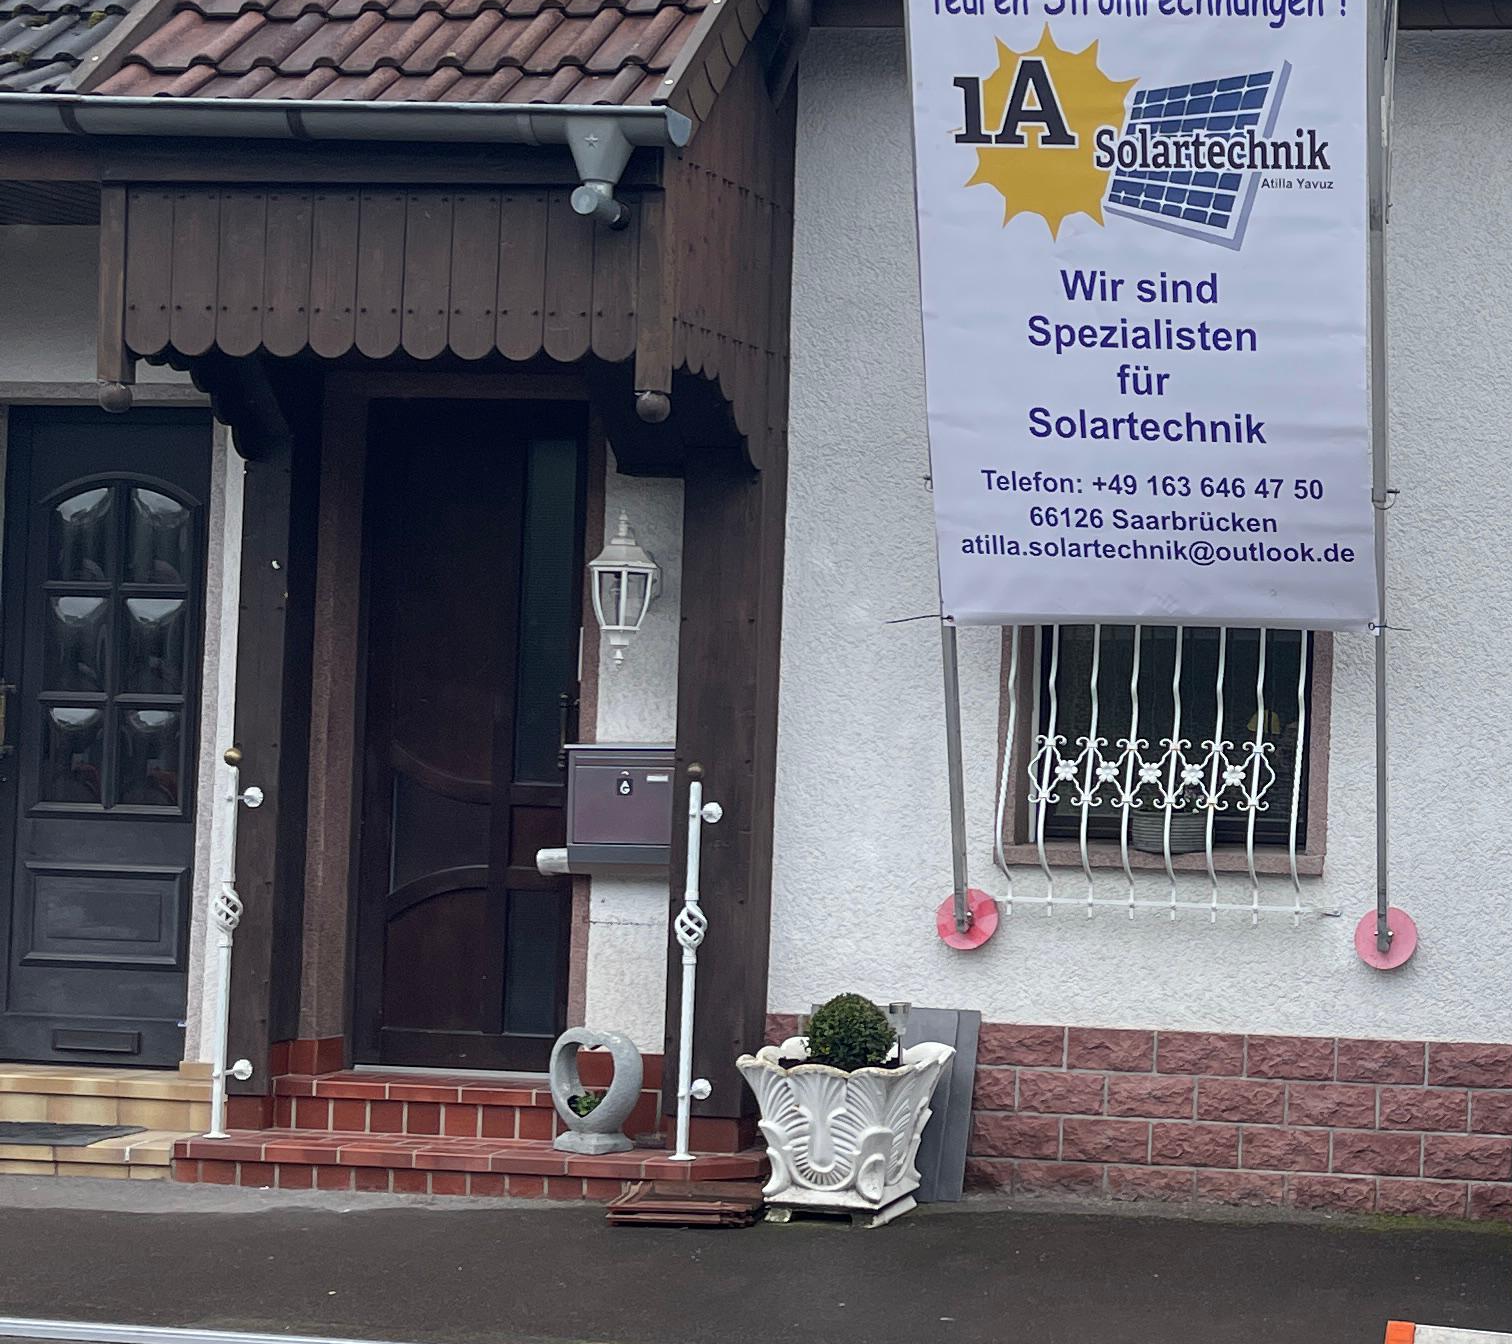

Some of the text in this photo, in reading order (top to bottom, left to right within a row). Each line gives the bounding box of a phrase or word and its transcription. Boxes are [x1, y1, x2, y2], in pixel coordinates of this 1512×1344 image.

[953, 59, 1076, 146] 1A
[1095, 128, 1331, 171] Solartechnik
[1261, 177, 1334, 191] Atilla Yavuz
[1060, 269, 1219, 304] Wir sind
[1027, 315, 1257, 355] Spezialisten
[1116, 363, 1171, 396] für
[1028, 407, 1267, 444] Solartechnik
[981, 469, 1324, 500] Telefon: +49 163 646 47 50
[1029, 506, 1278, 533] 66126 Saarbrücken
[961, 534, 1356, 567] atilla.solartechnik@outlook.de
